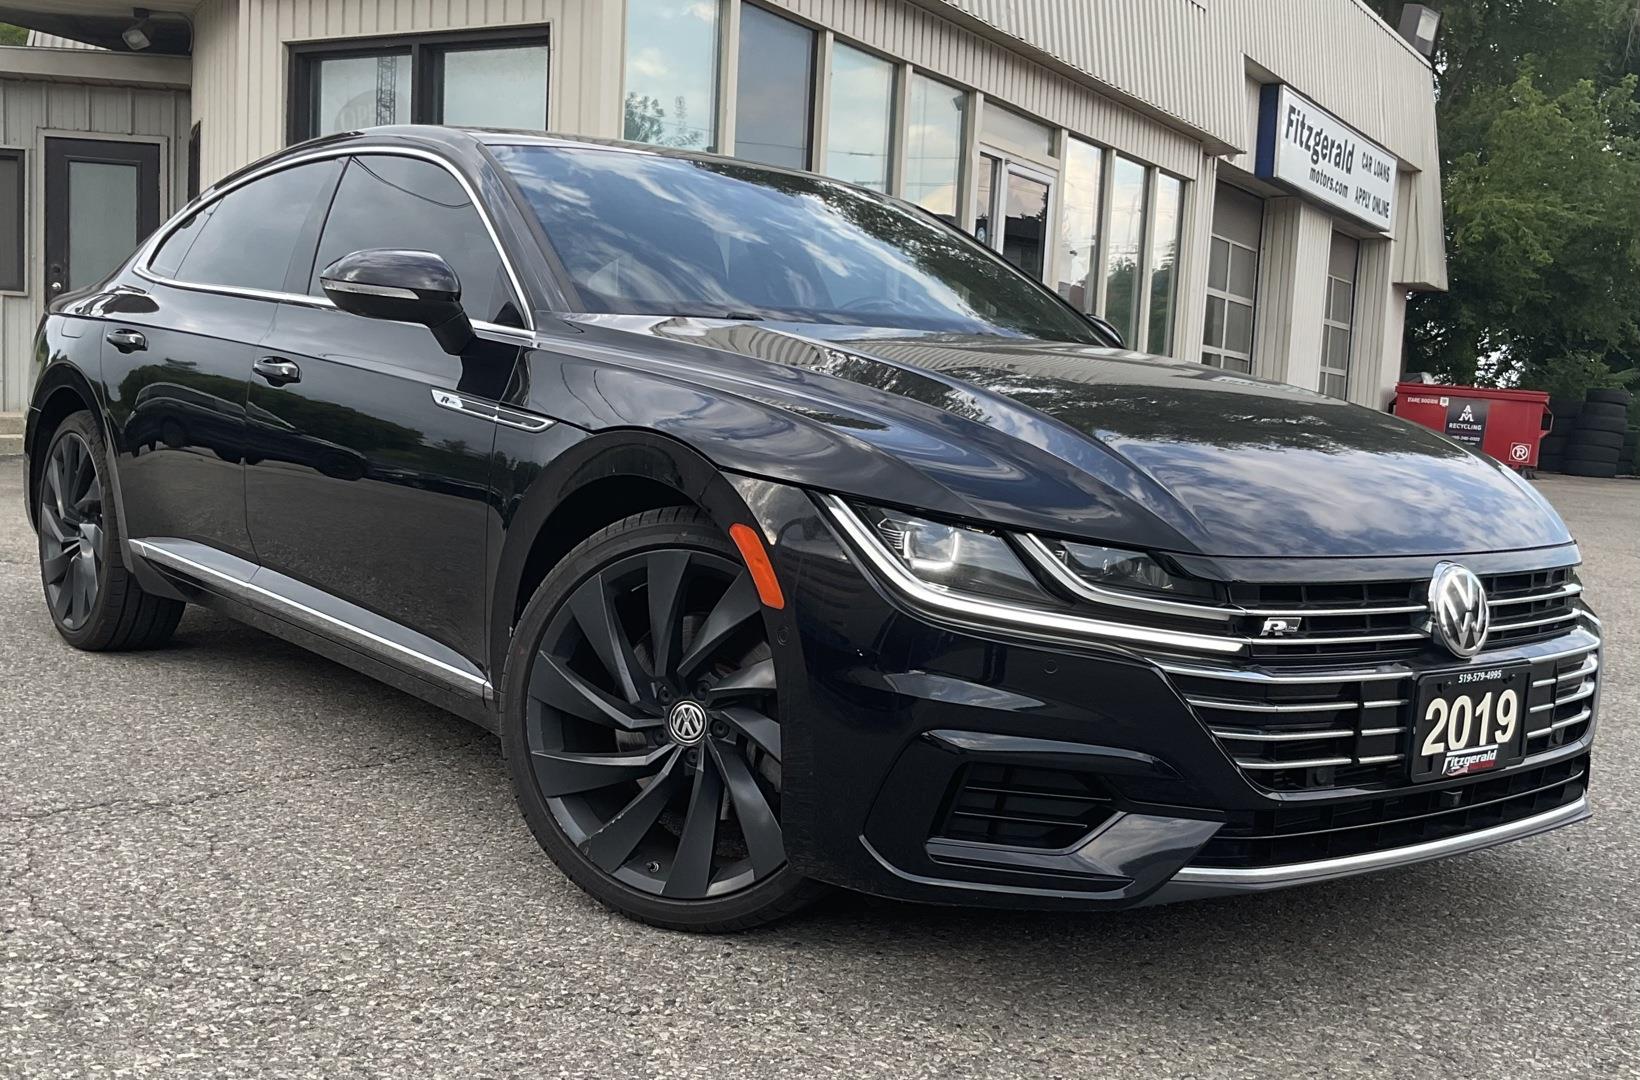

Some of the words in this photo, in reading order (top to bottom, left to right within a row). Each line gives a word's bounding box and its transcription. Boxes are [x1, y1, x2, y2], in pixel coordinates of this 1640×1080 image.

[1285, 104, 1355, 175] Fitzgerald
[1309, 167, 1348, 198] motors.com
[1362, 152, 1372, 173] CAR
[1374, 158, 1390, 183] LOANS
[1355, 185, 1371, 209] APPLY
[1372, 195, 1389, 219] ONLINE
[1448, 422, 1482, 431] RECYCLING
[1458, 670, 1502, 683] 519-579-4995
[1421, 689, 1518, 756] 2019
[1441, 748, 1498, 774] Fitzgerald
